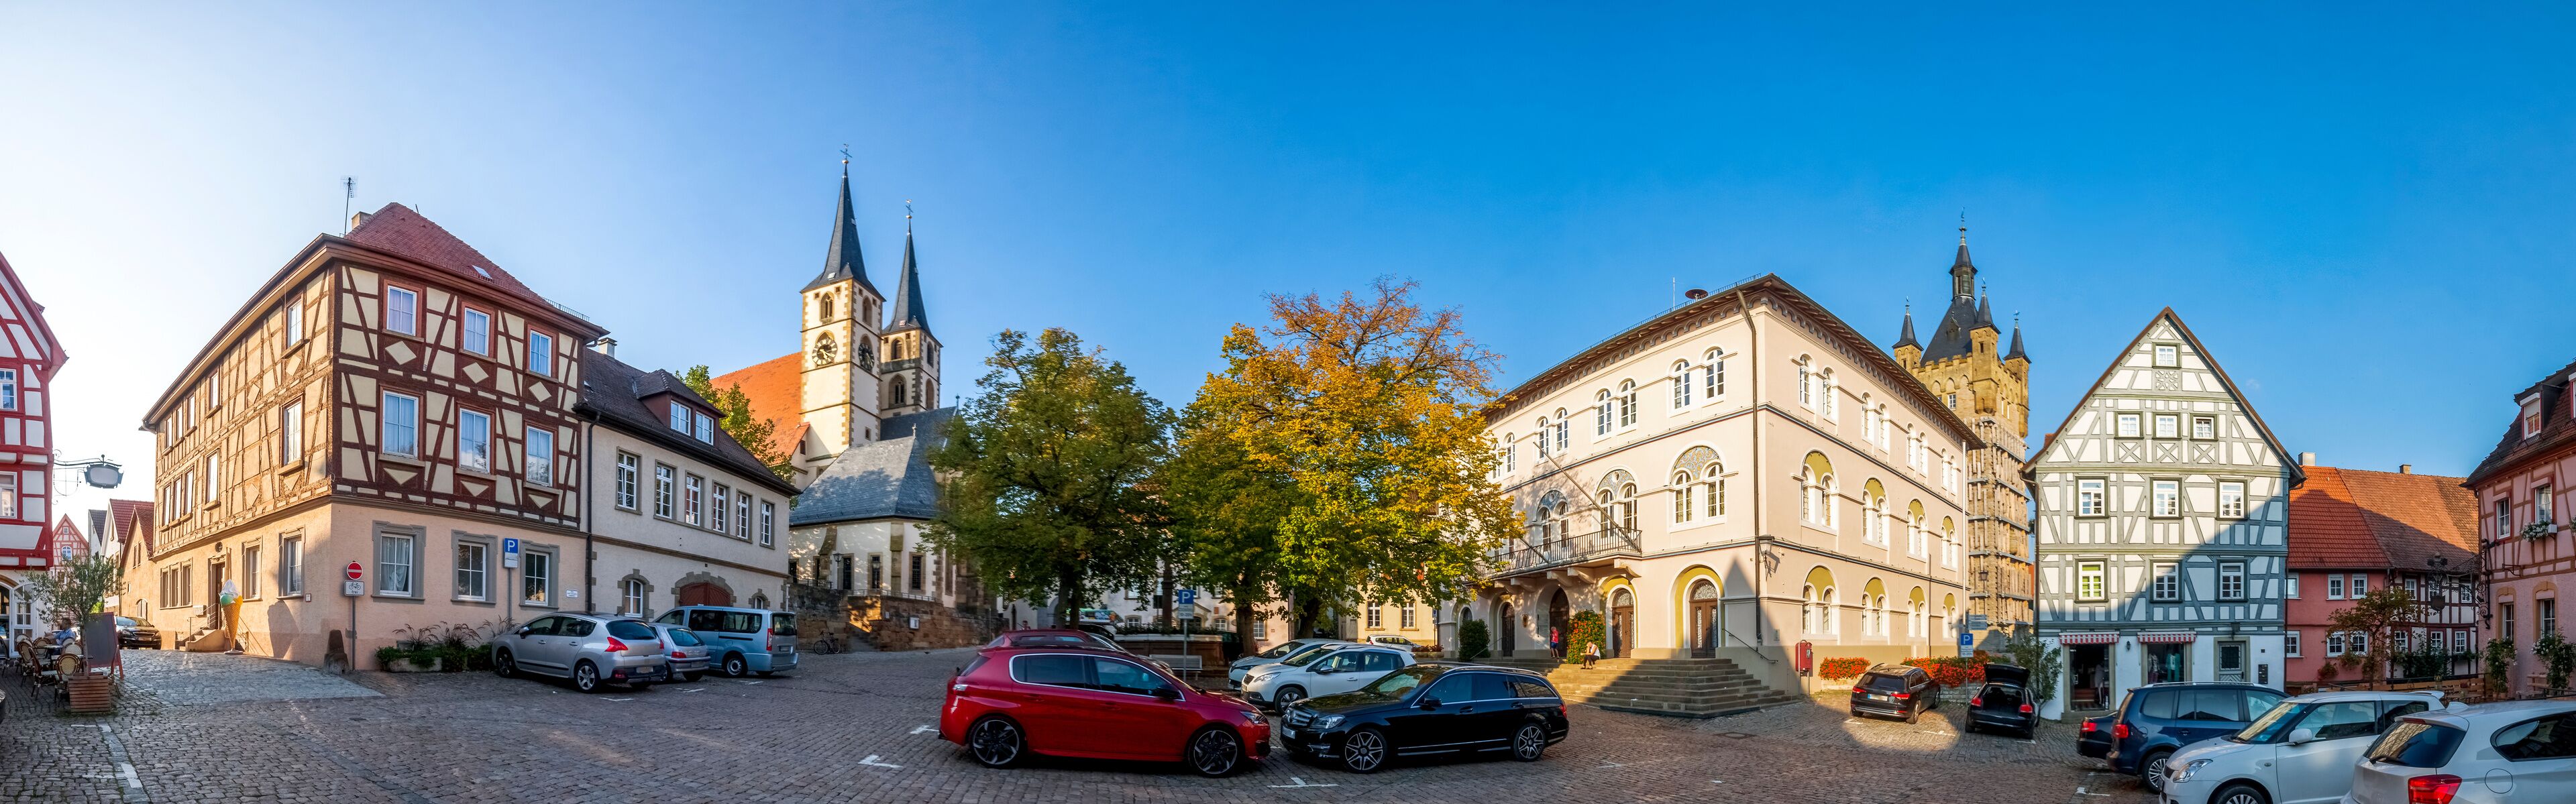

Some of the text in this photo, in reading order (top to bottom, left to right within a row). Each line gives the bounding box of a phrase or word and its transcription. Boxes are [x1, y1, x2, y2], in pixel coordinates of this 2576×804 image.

[508, 540, 515, 552] P
[1182, 591, 1191, 603] P
[1964, 634, 1970, 644] P
